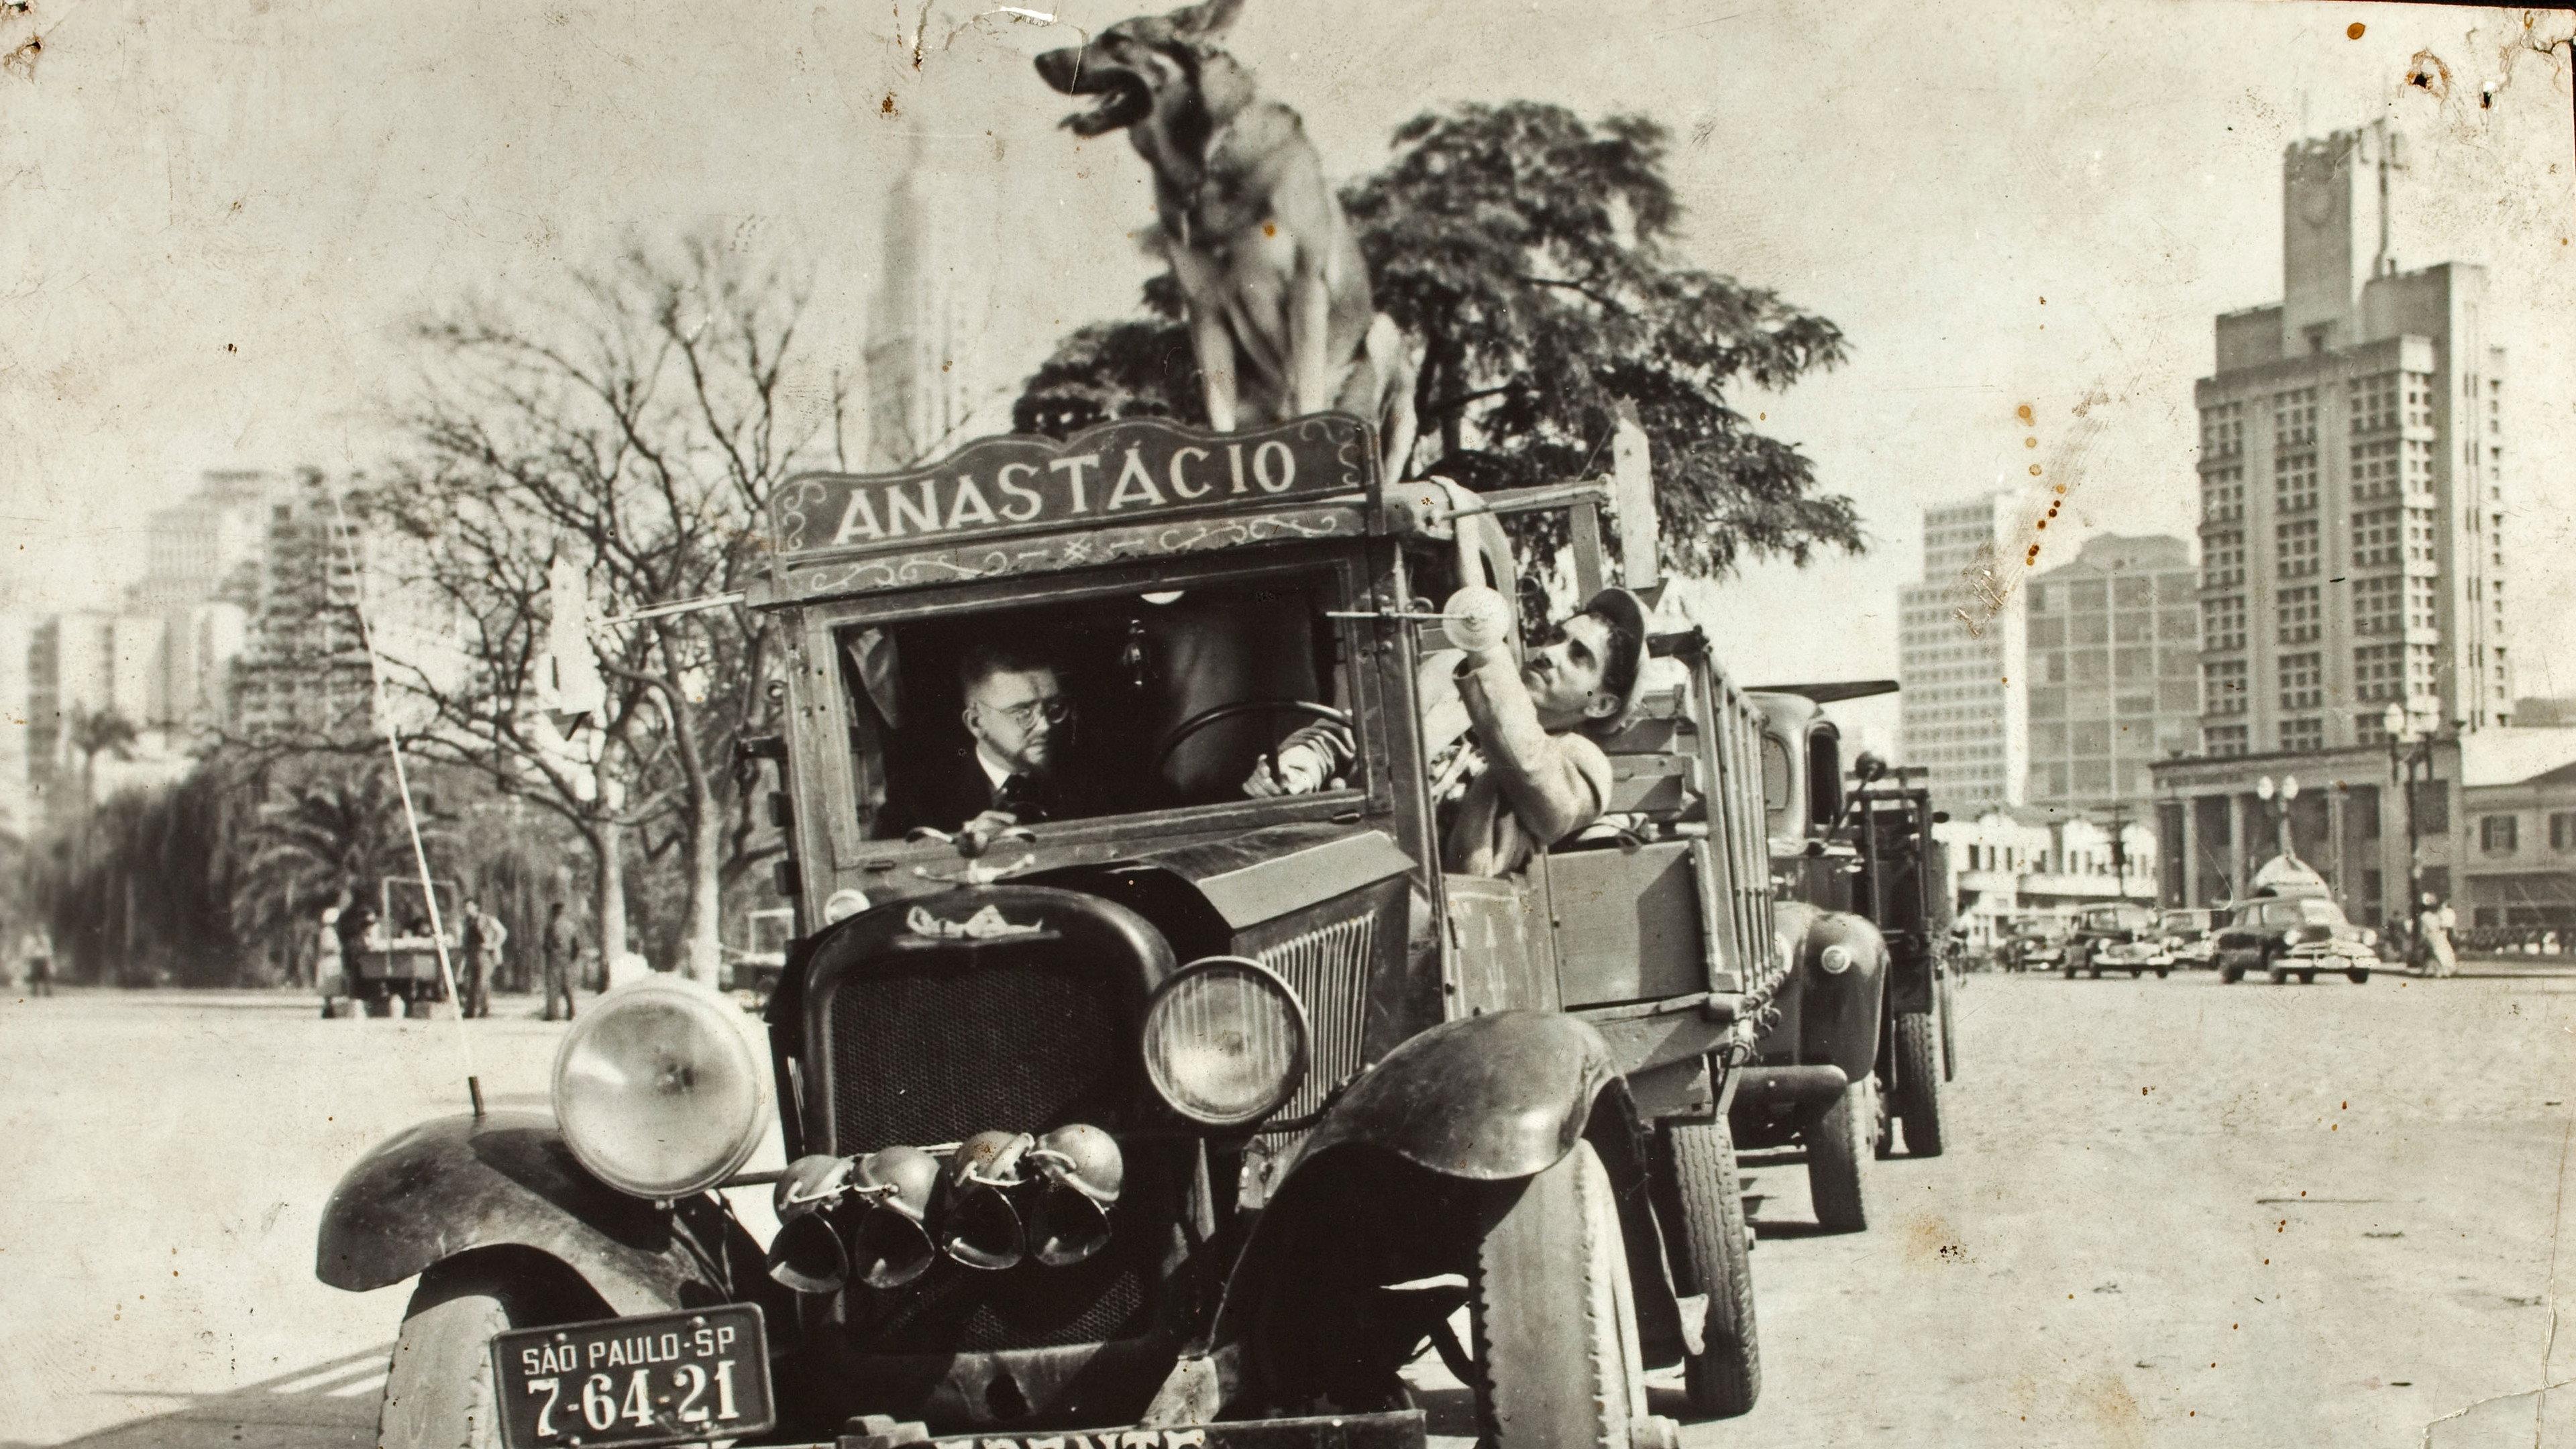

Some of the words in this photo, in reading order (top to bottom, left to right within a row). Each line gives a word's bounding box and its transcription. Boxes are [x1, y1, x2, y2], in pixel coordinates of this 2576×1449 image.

[831, 439, 1296, 547] ANASTÁCIO
[523, 1342, 577, 1375] SÃO
[527, 1360, 739, 1436] 7-64-21
